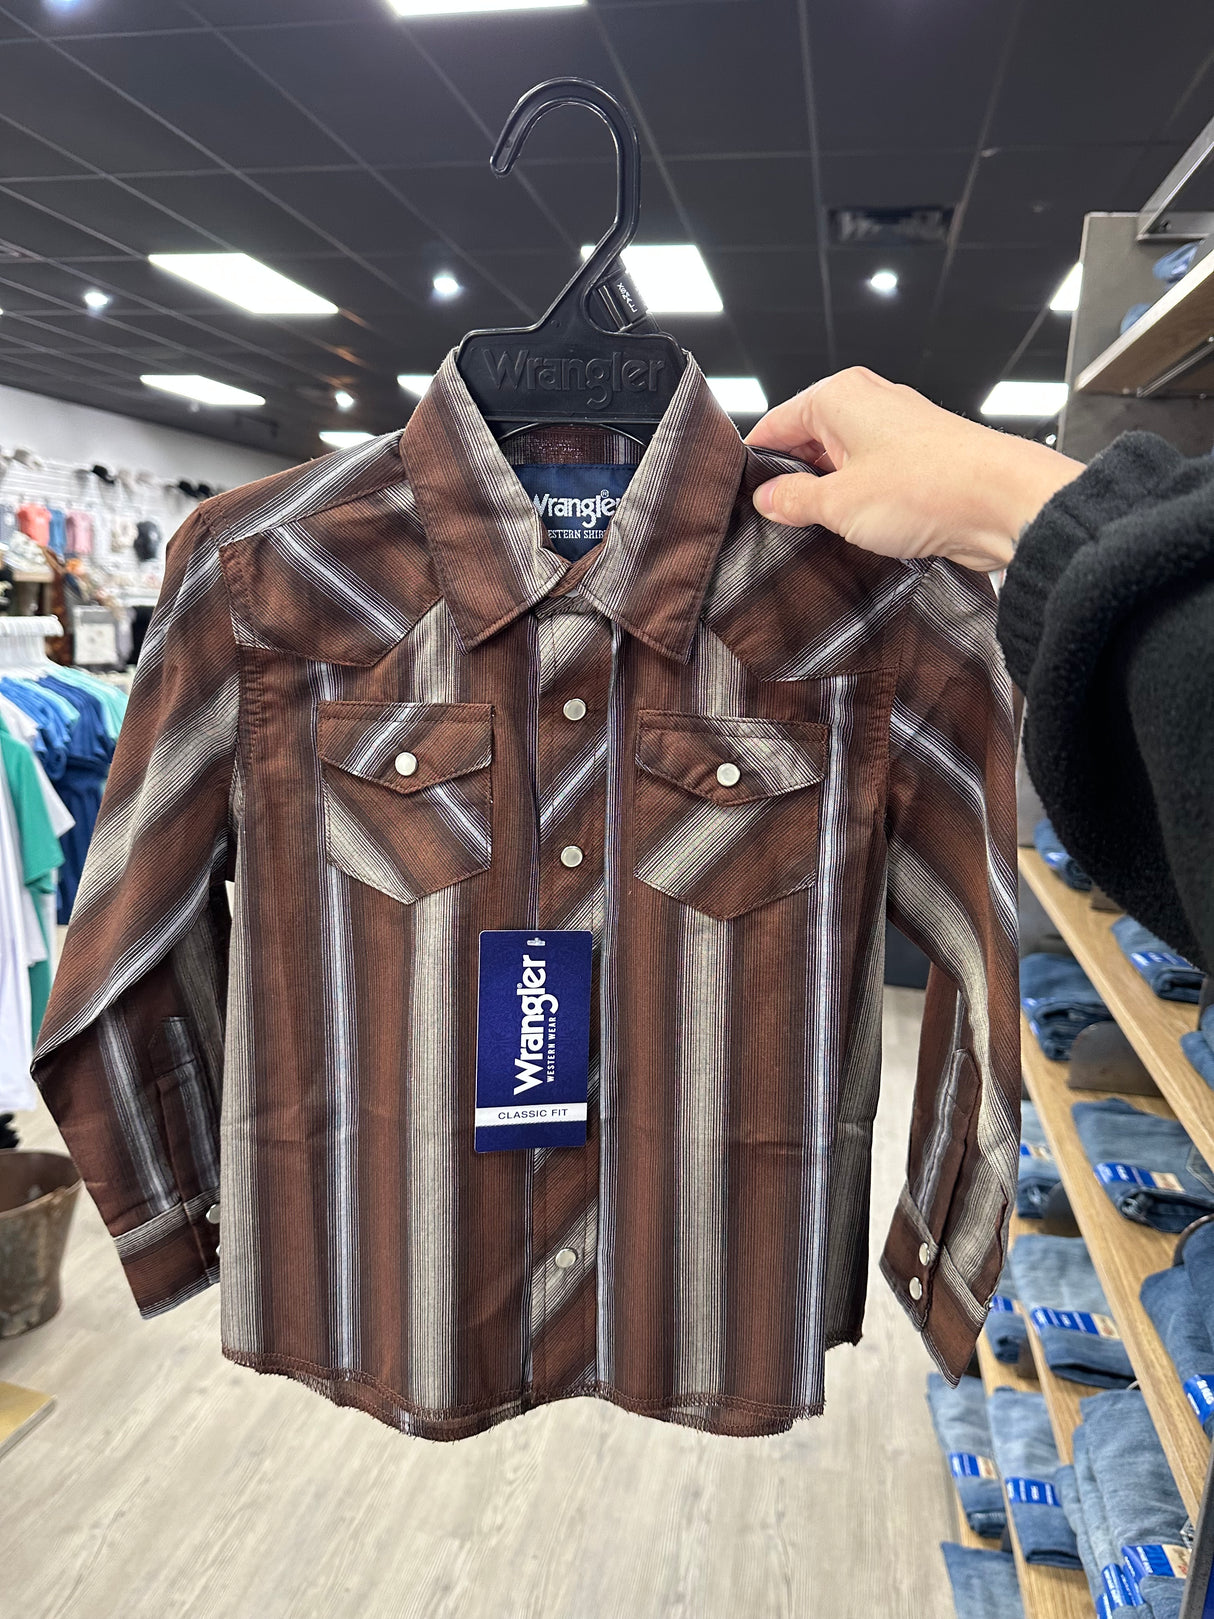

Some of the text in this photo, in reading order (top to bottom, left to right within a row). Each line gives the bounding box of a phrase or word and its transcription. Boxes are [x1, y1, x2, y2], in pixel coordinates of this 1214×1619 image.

[482, 349, 665, 411] Wrangler
[547, 529, 606, 539] ESTERN SHIR
[513, 954, 559, 1096] Wrangler
[546, 1016, 557, 1083] WESTERN WEAR
[498, 1108, 568, 1120] CLASSIC FIT
